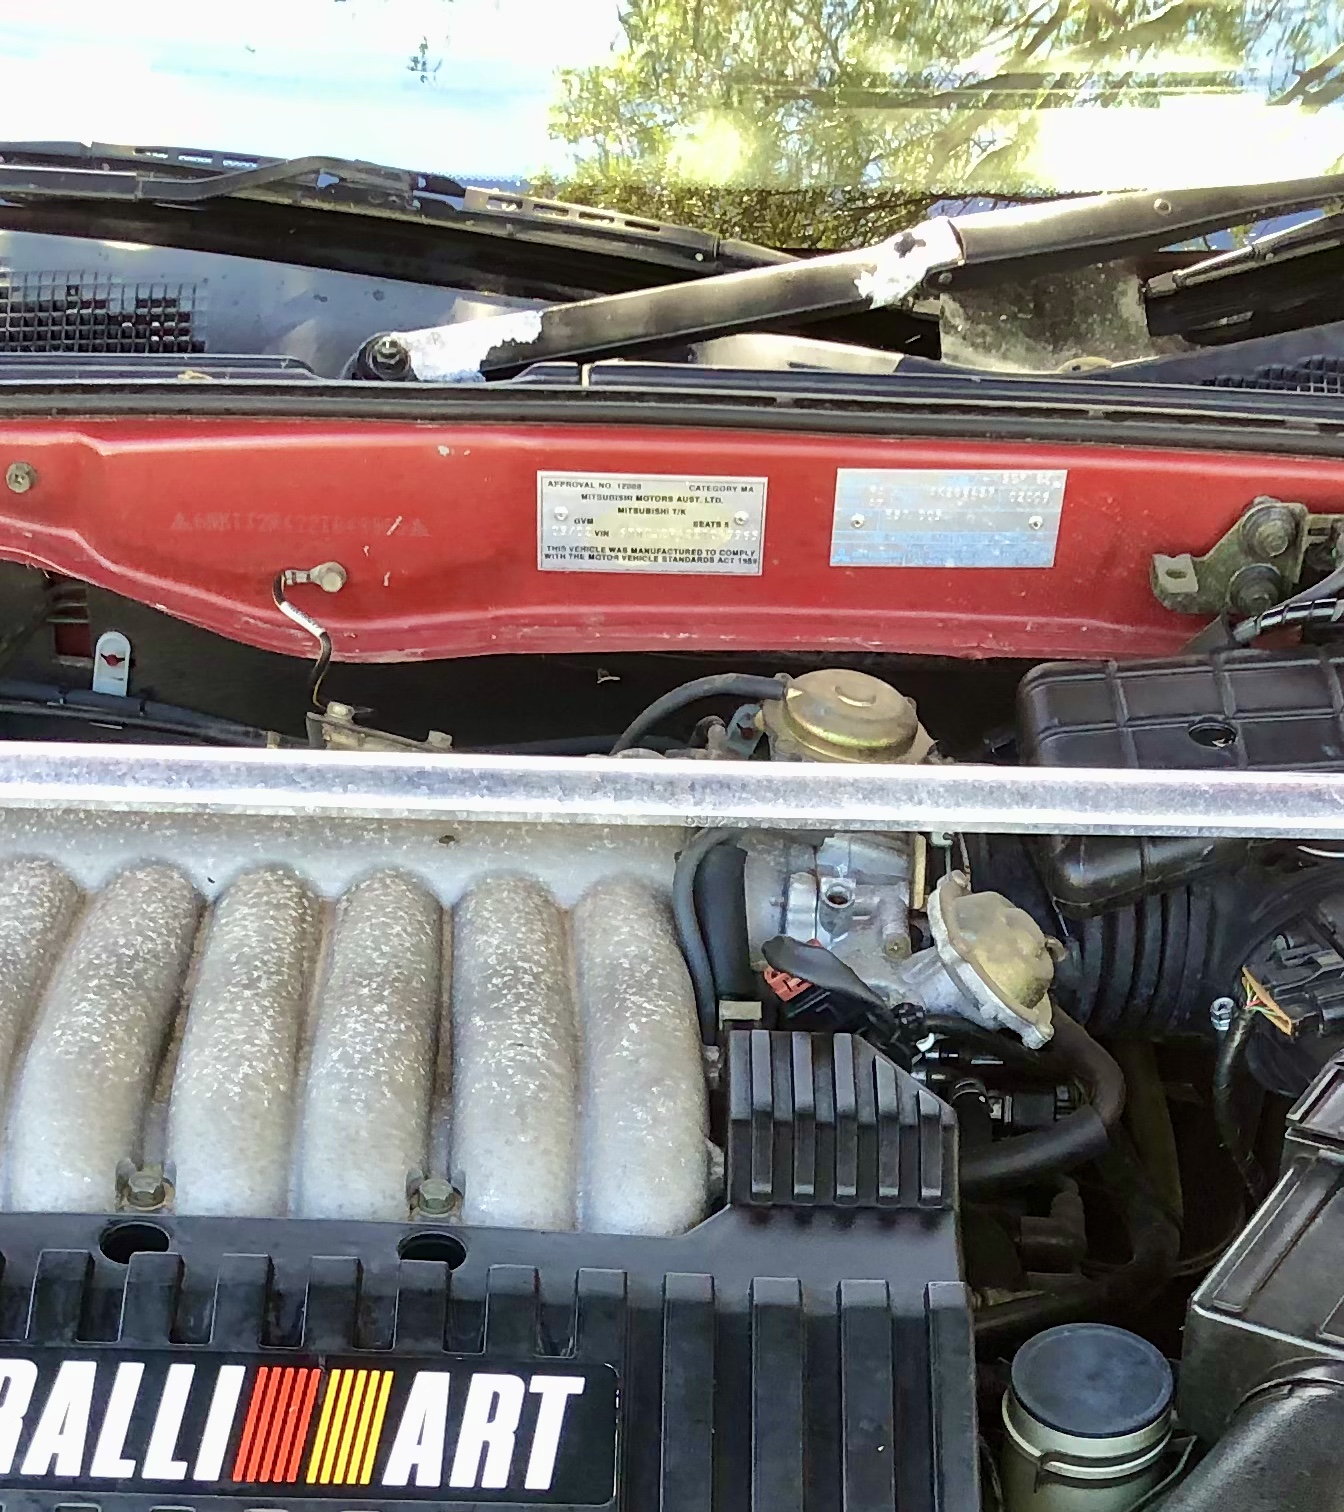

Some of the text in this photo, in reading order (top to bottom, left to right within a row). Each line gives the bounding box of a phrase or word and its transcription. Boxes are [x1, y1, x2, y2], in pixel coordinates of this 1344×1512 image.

[548, 480, 595, 489] APPROVAL
[689, 484, 737, 493] CATEGORY
[581, 493, 633, 502] MITSUBISHI
[635, 494, 674, 503] MOTORS
[617, 507, 670, 515] MITSUBISHI
[547, 545, 567, 553] THIS
[631, 547, 702, 556] MANUFACTURED
[719, 549, 756, 557] COMPLY
[622, 555, 658, 563] VEHICLE
[662, 555, 715, 564] STANDARDS
[381, 1370, 587, 1491] ART
